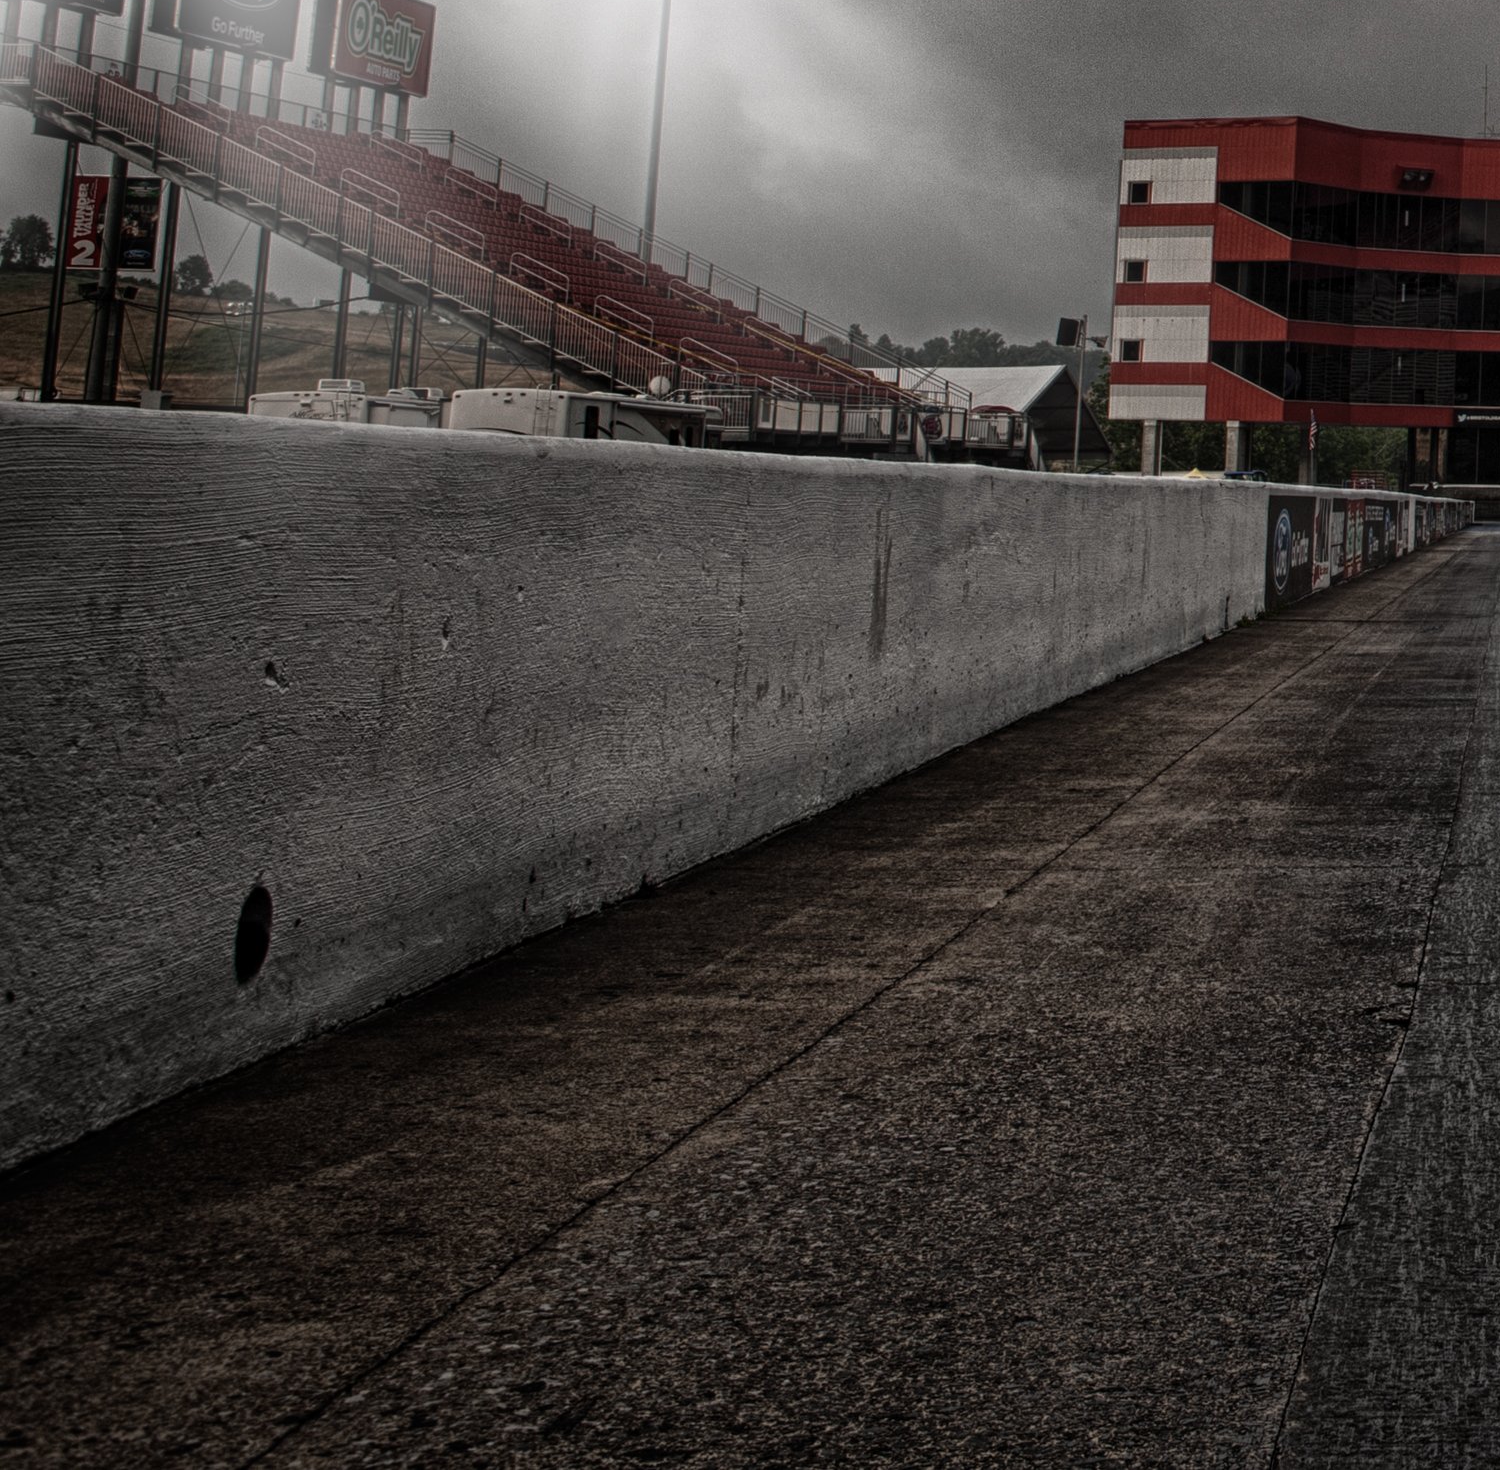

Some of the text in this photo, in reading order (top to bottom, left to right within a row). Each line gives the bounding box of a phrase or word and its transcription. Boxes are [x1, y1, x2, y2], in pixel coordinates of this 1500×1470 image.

[211, 17, 264, 46] Go Further
[73, 182, 89, 238] THUNDER
[71, 239, 96, 266] 2
